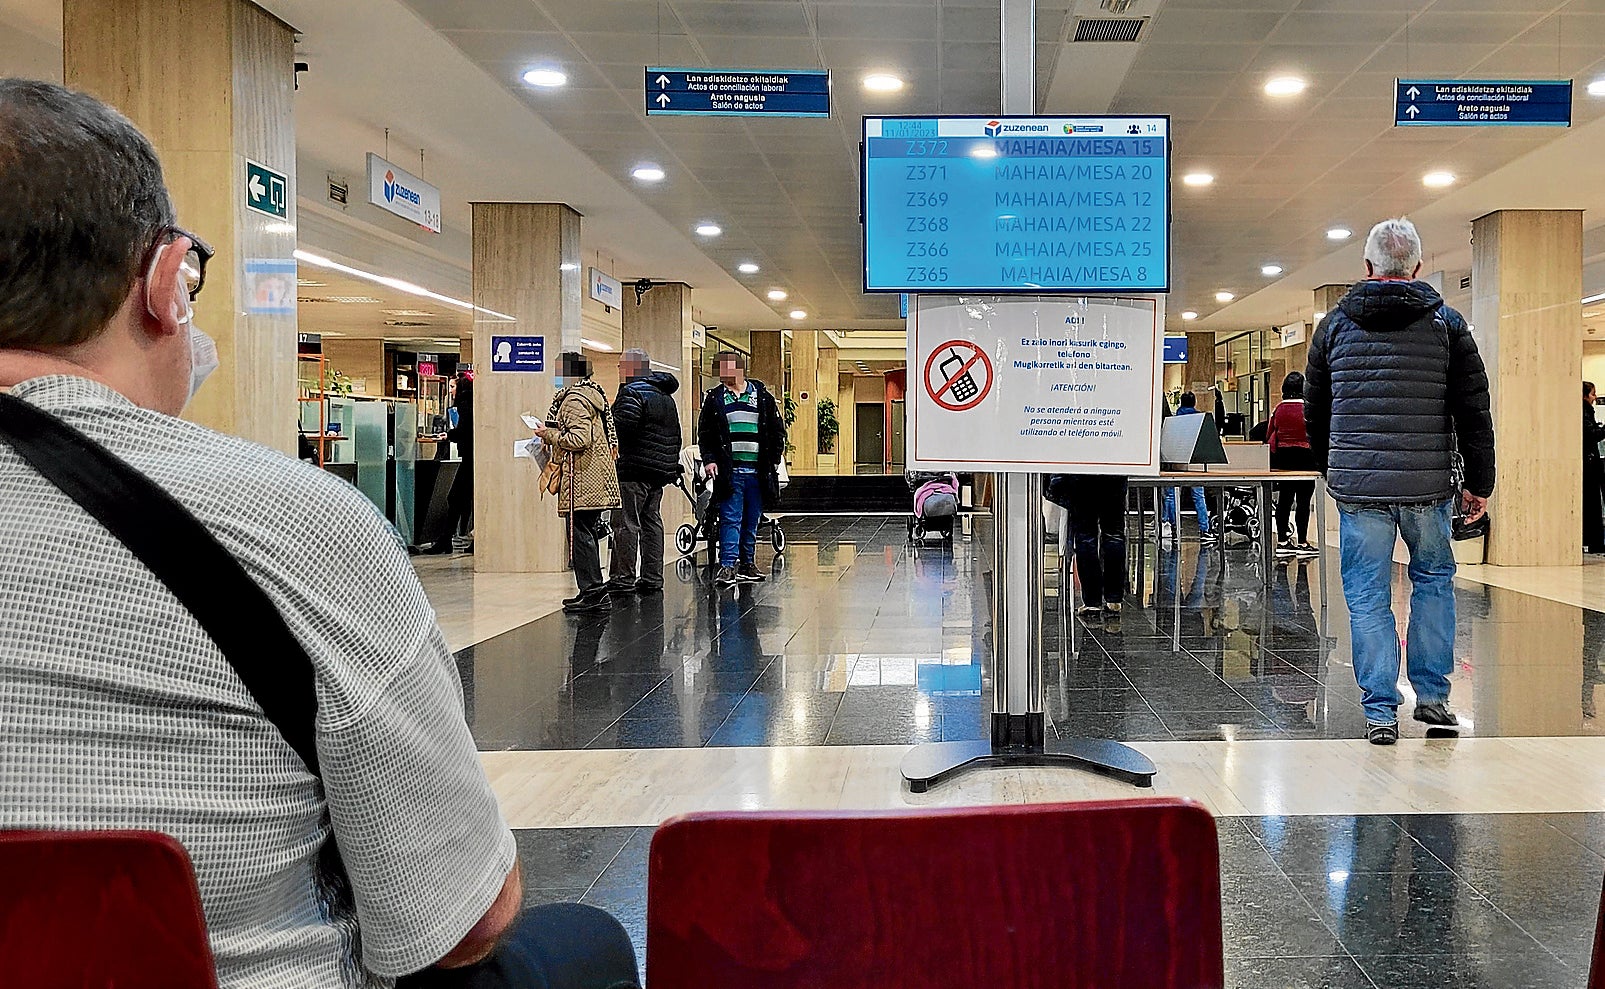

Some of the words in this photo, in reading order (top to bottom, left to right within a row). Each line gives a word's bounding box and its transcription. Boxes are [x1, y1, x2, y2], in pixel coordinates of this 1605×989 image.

[686, 75, 702, 83] Lan
[719, 84, 760, 92] conciliación
[761, 84, 785, 92] laboral
[710, 93, 732, 101] Areto
[734, 94, 766, 103] nagusia
[1480, 105, 1510, 113] nagusia
[1003, 124, 1049, 132] zuzenean
[1146, 124, 1157, 132] 14
[906, 140, 948, 156] Z372
[995, 140, 1126, 156] MAHAIA/MESA
[1132, 140, 1152, 155] 15
[906, 165, 946, 180] Z371
[995, 165, 1126, 181] MAHAIA/MESA
[1131, 165, 1152, 180] 20
[906, 192, 948, 207] Z369
[995, 192, 1126, 208] MAHAIA/MESA
[1132, 192, 1151, 206] 12
[906, 217, 948, 232] Z368
[995, 217, 1126, 233] MAHAIA/MESA
[1131, 217, 1151, 231] 22
[906, 242, 948, 257] Z366
[995, 242, 1126, 258] MAHAIA/MESA
[1131, 242, 1151, 257] 25
[906, 267, 948, 282] Z365
[1001, 267, 1132, 283] MAHAIA/MESA
[1136, 266, 1147, 281] 8
[1021, 338, 1030, 346] Ez
[1049, 338, 1067, 346] inori
[1099, 340, 1127, 350] egingo,
[1013, 361, 1065, 370] Mugikorretik
[1078, 361, 1094, 370] den
[1050, 382, 1097, 392] ¡ATENCIÓN!
[1023, 405, 1036, 413] No
[1046, 406, 1082, 414] atenderá
[1090, 407, 1121, 416] ninguna
[1030, 417, 1062, 426] persona
[1063, 418, 1097, 426] mientras
[1098, 418, 1115, 427] esté
[1020, 428, 1058, 437] utilizando
[1059, 429, 1067, 437] el
[1068, 428, 1100, 438] teléfono
[1101, 429, 1124, 438] móvil.
